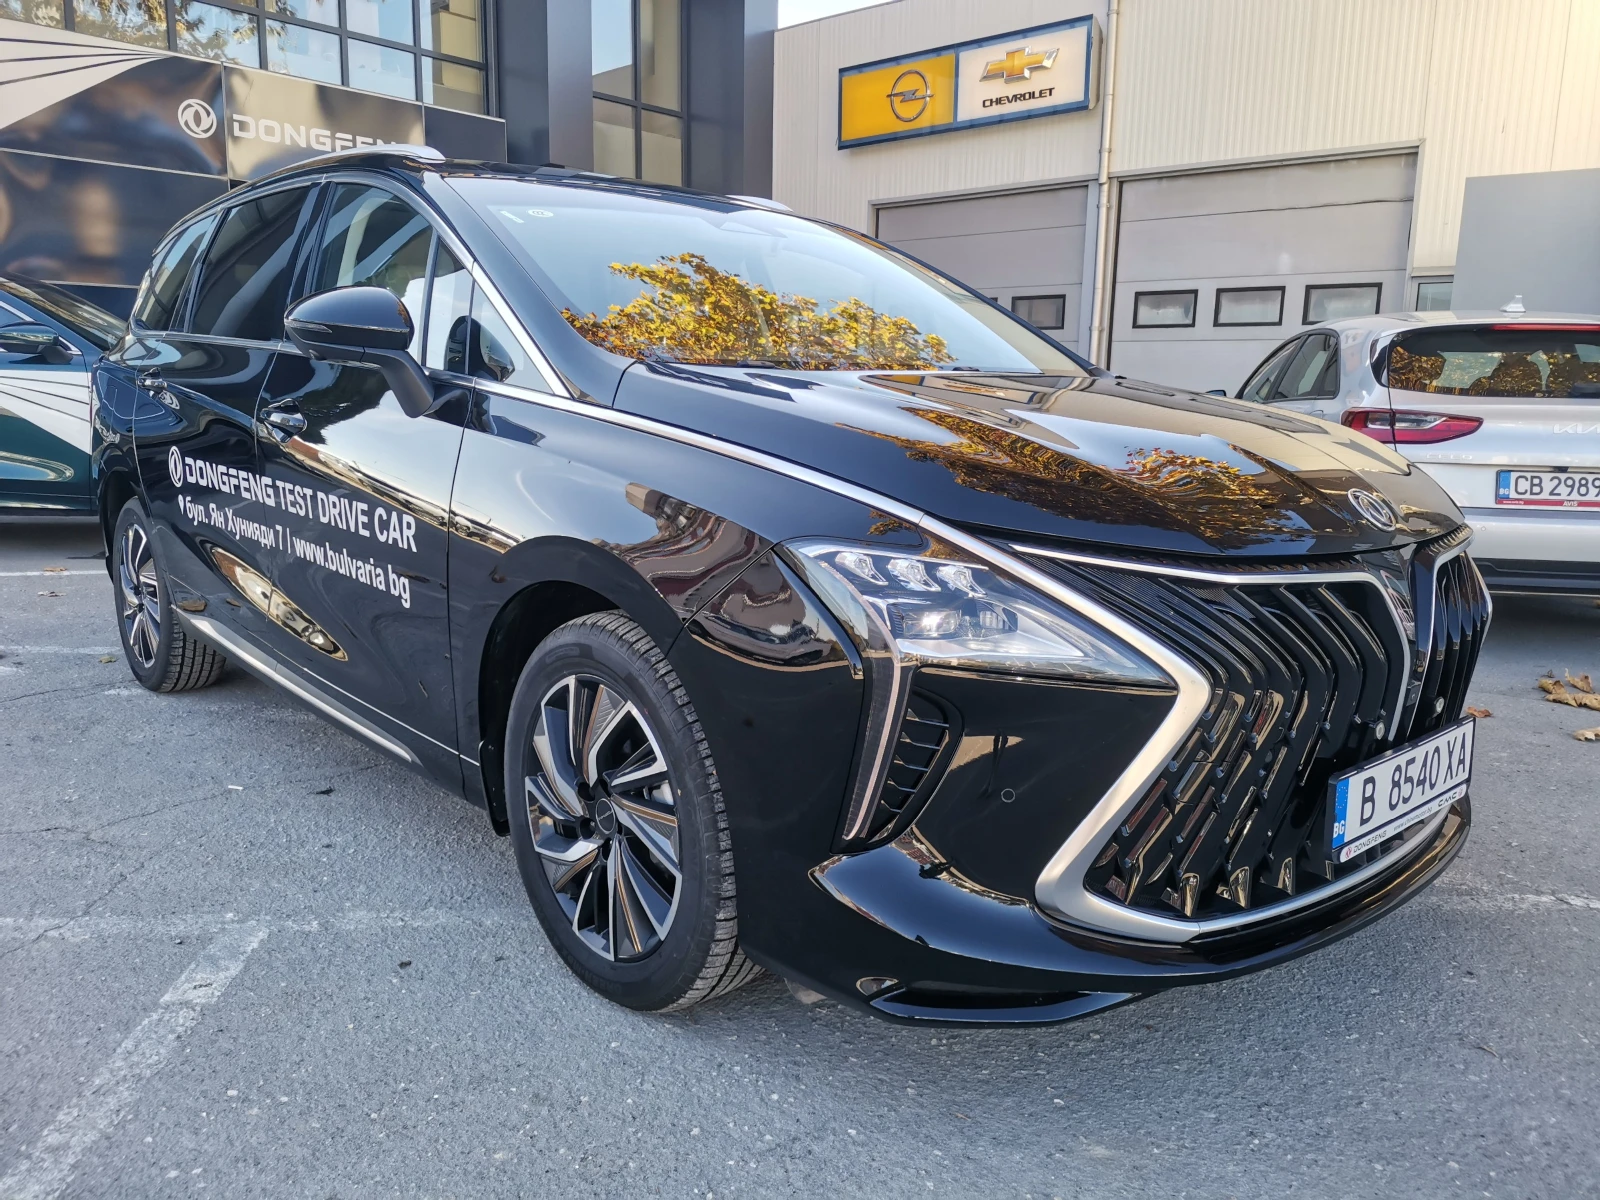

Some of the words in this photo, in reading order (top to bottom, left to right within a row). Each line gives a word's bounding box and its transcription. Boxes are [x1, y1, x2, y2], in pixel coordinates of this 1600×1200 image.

[982, 87, 1055, 108] CHEVROLET
[185, 456, 276, 507] DONGFENG
[275, 480, 313, 519] TEST
[317, 491, 371, 538] DRIVE
[374, 506, 418, 553] CAR
[1514, 475, 1544, 496] CB
[1548, 475, 1600, 498] 2989
[185, 496, 209, 526] бул.
[210, 503, 226, 530] Ян
[225, 507, 276, 550] Хунияди
[275, 525, 283, 550] 7
[1359, 775, 1377, 827] B
[1388, 745, 1441, 812] 8540
[1443, 732, 1467, 785] XA
[1333, 820, 1346, 838] BG
